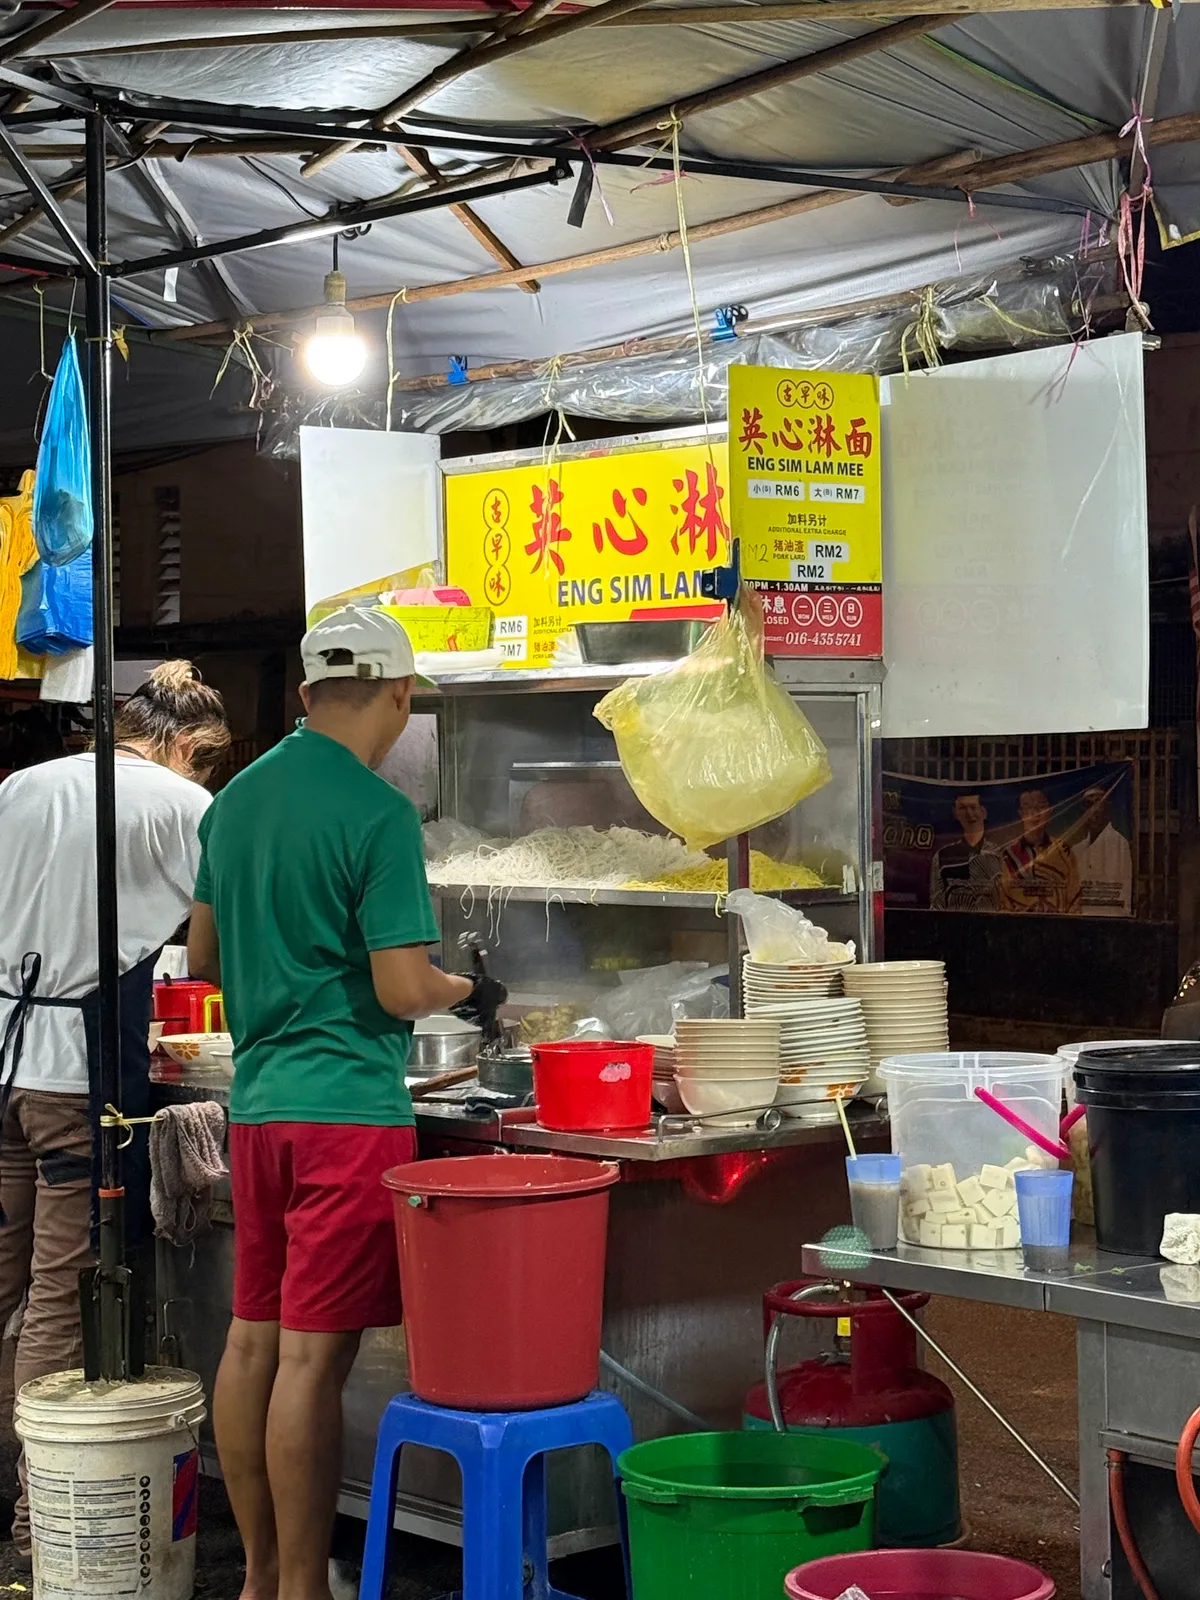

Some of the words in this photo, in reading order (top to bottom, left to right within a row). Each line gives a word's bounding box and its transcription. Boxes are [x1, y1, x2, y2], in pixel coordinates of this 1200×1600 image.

[780, 382, 831, 407] 古早味
[738, 407, 873, 459] 英心淋面
[747, 456, 775, 471] ENG
[778, 458, 802, 473] SIM
[805, 460, 834, 475] LAM
[837, 462, 864, 477] MEE
[775, 484, 800, 497] RM6
[836, 488, 860, 500] RM7
[787, 513, 827, 527] 加料另计
[768, 526, 802, 534] ADDITIONAL
[488, 494, 508, 602] 古早味
[815, 544, 842, 558] RM2
[798, 564, 825, 579] RM2
[557, 578, 603, 608] ENG
[610, 574, 651, 604] SIM
[776, 582, 809, 592] 1.30AM
[823, 602, 832, 613] 三
[500, 620, 523, 634] RM6
[764, 616, 789, 625] OSED
